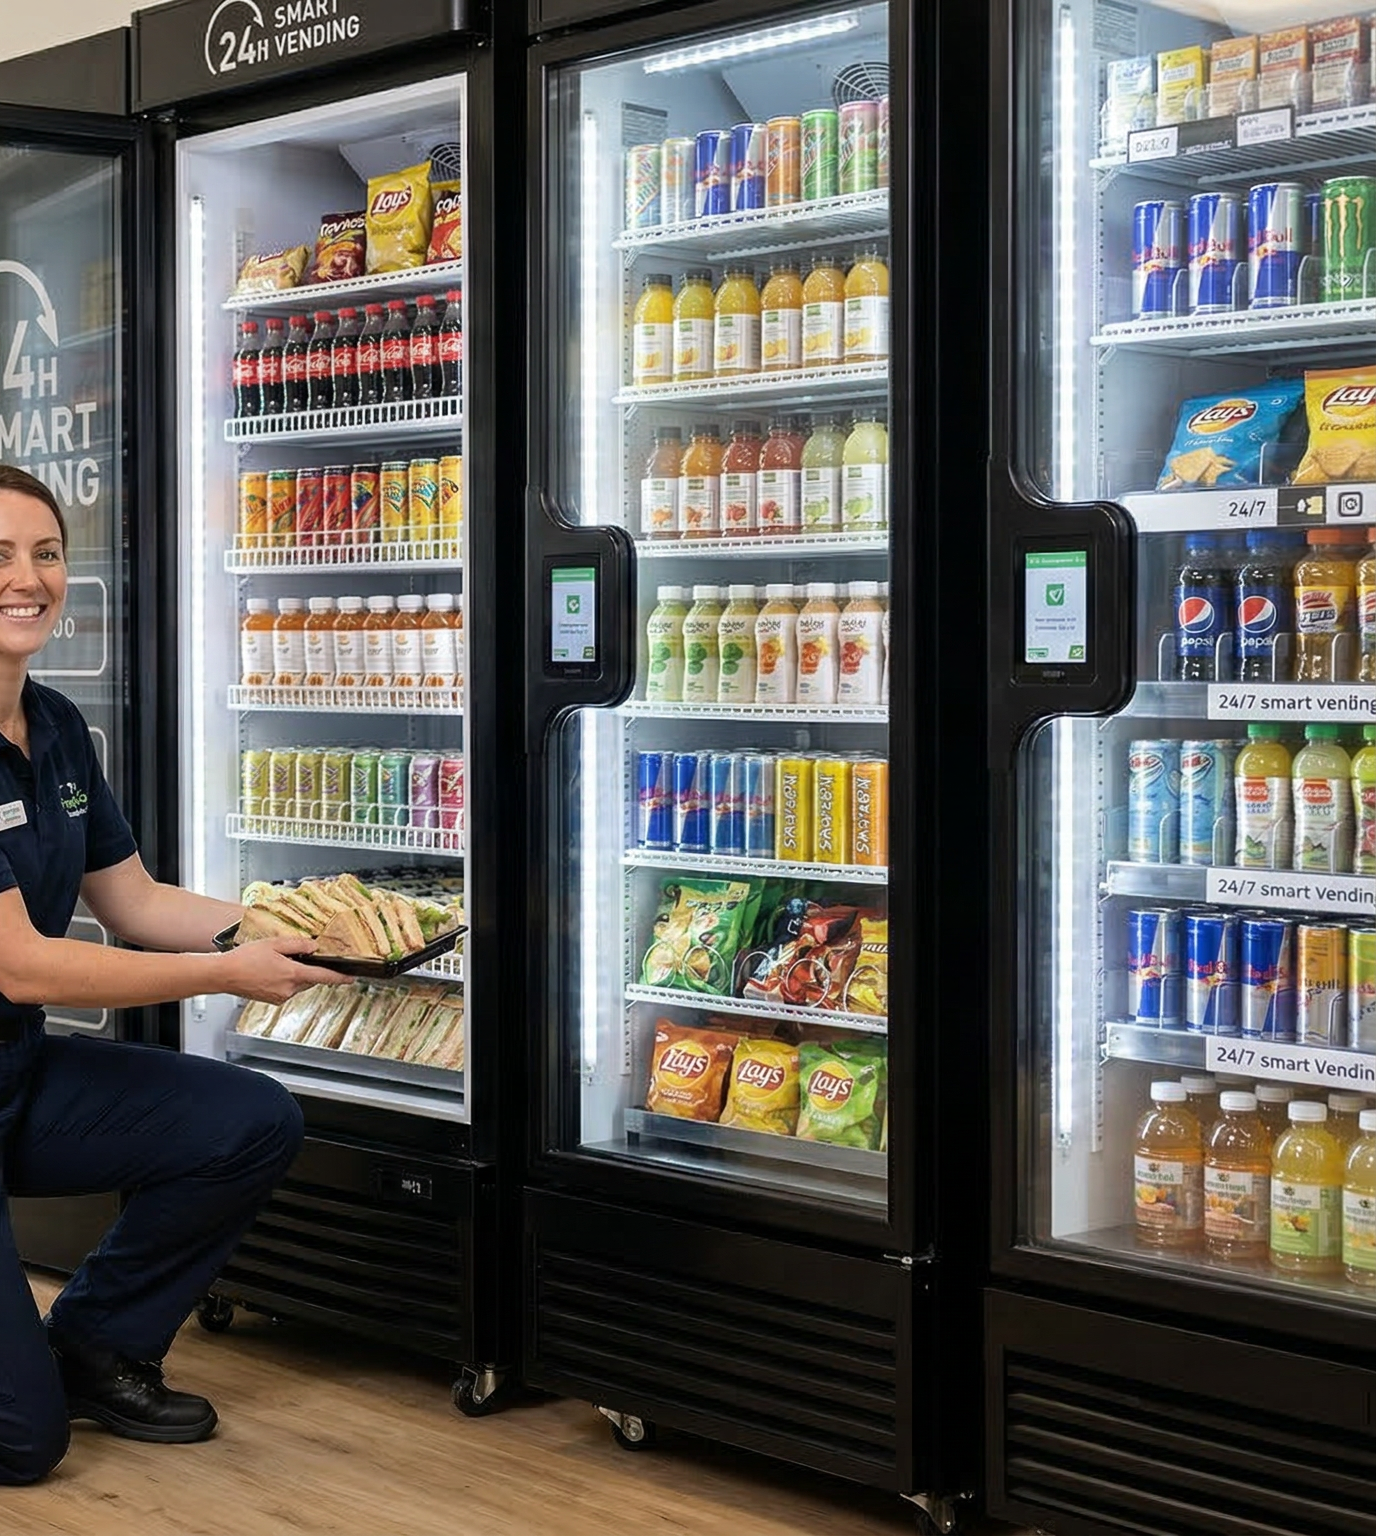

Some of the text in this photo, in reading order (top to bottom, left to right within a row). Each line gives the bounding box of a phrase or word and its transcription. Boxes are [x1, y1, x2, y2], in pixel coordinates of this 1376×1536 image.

[274, 15, 360, 57] VENDING
[1228, 501, 1266, 518] 24/7
[1219, 694, 1256, 710] 24/7
[1260, 695, 1312, 710] smart
[1218, 879, 1376, 907] 24/7 smart Vendin
[1217, 1046, 1255, 1066] 24/7
[1260, 1056, 1310, 1073] smart
